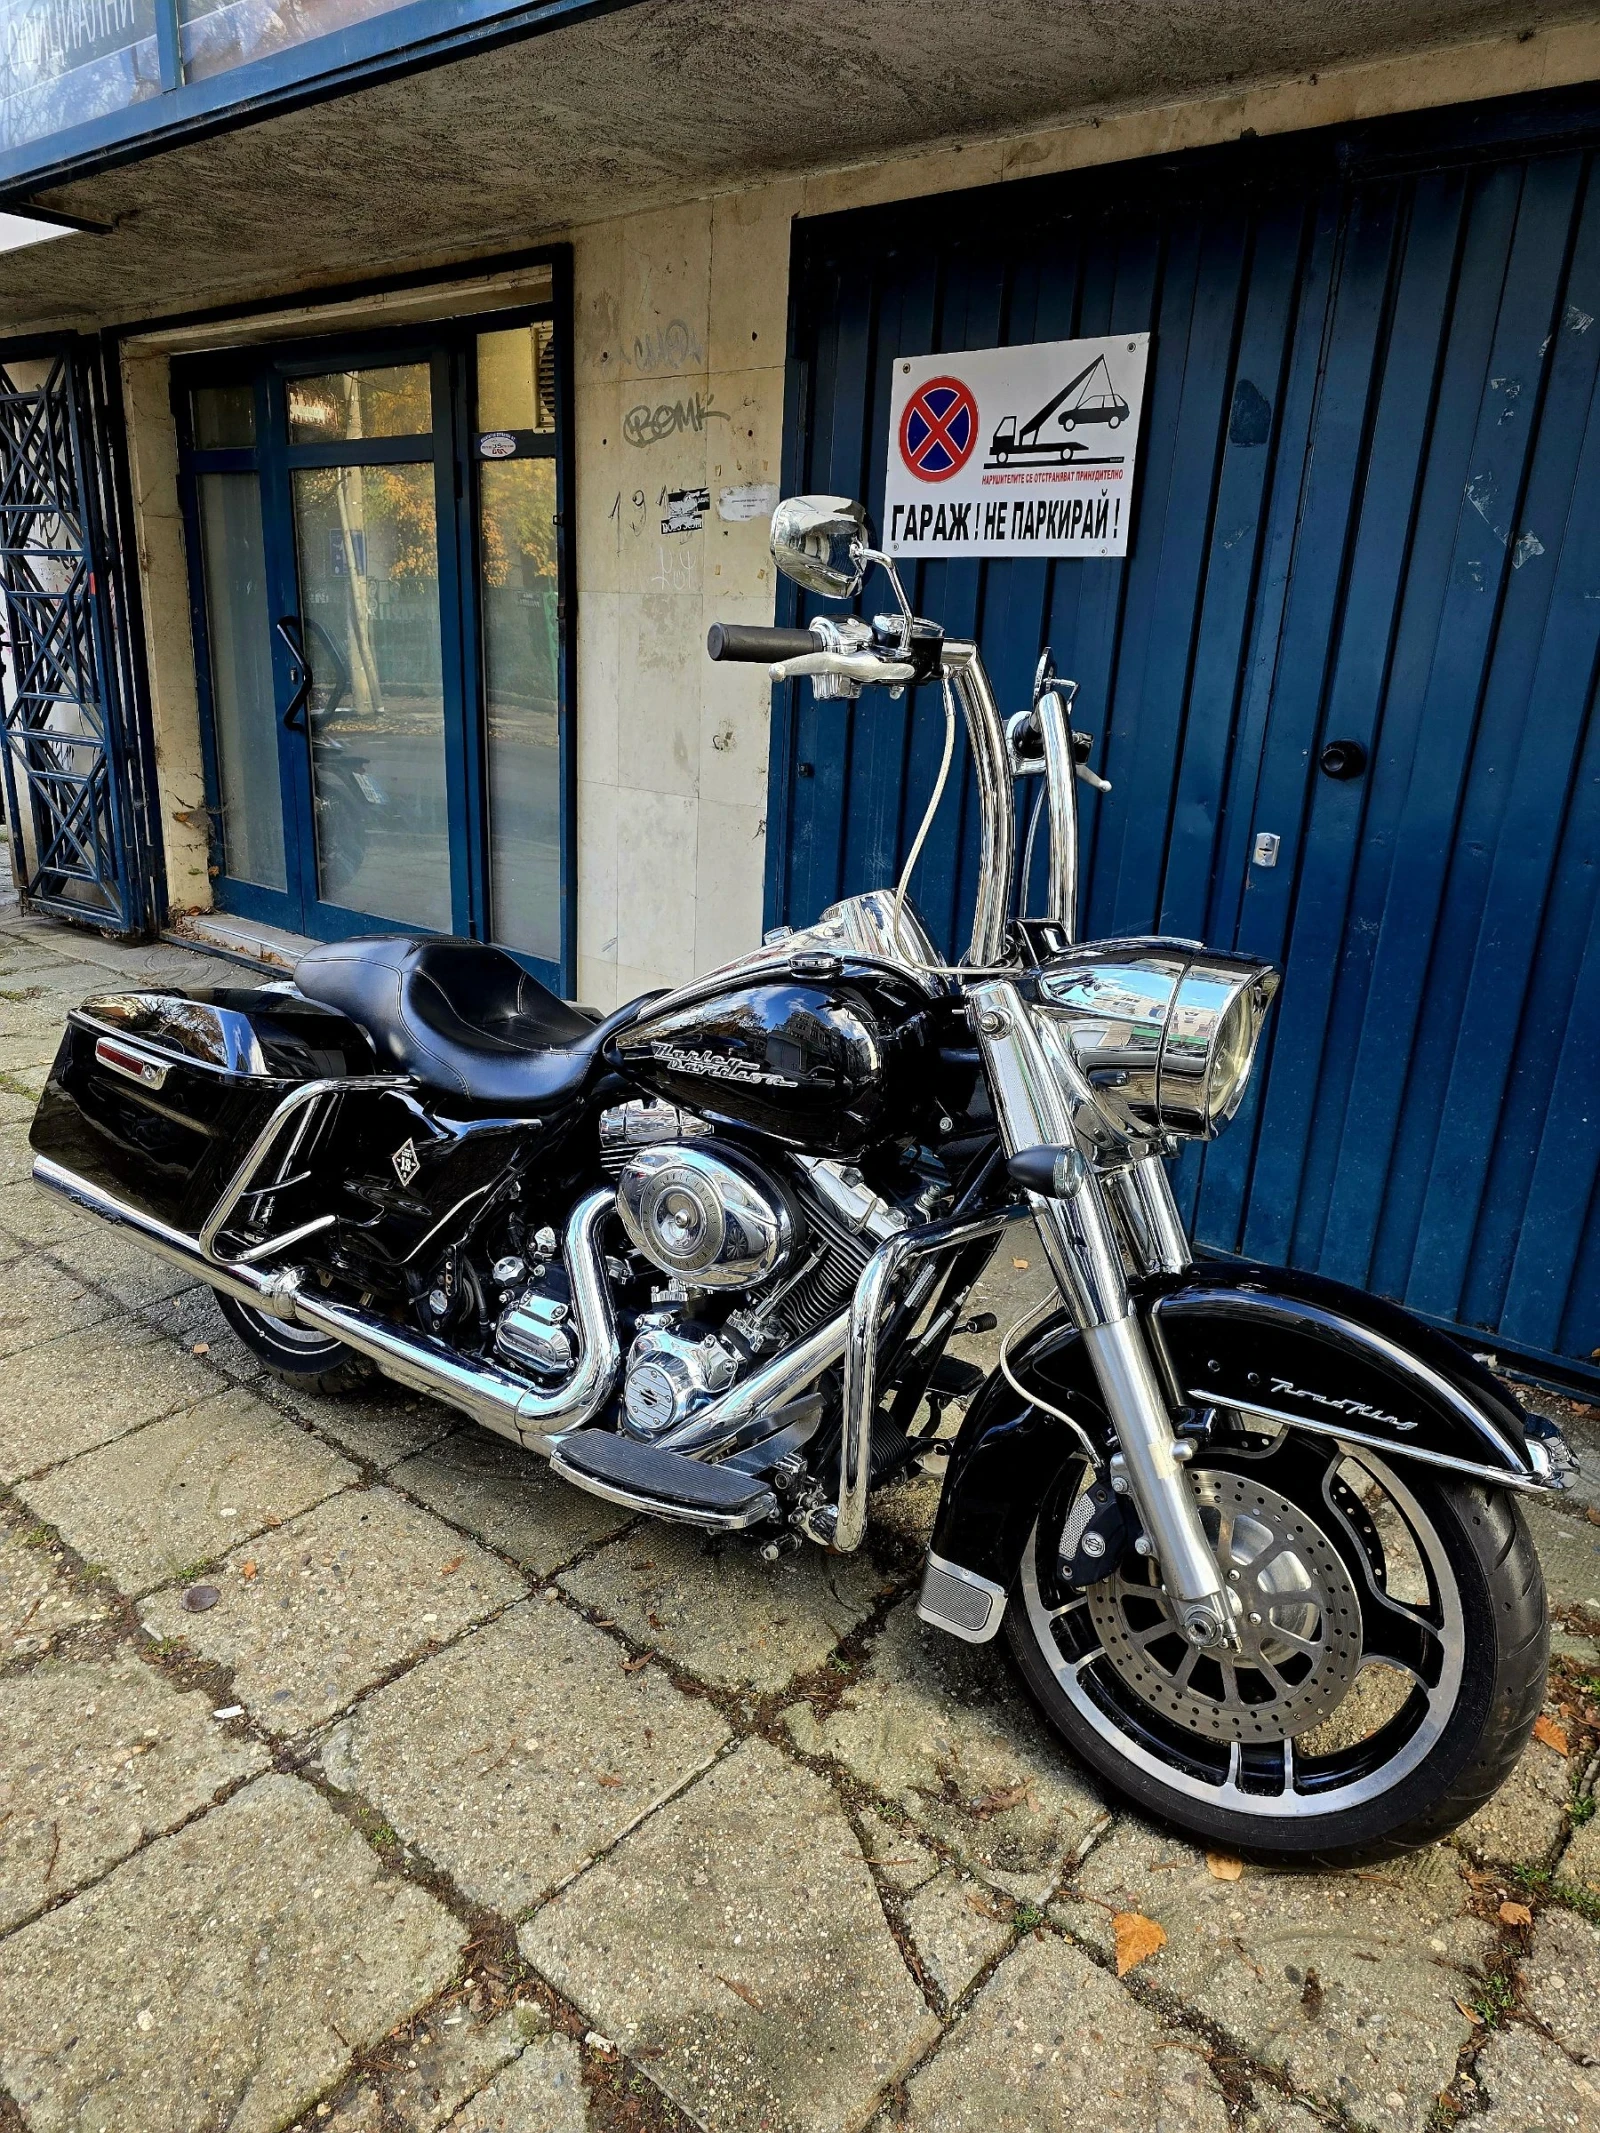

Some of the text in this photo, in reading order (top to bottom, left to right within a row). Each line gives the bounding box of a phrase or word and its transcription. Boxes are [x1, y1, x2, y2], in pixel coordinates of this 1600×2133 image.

[982, 469, 1124, 485] НАРУШИТЕЛИТЕ СЕ ОТСТРАНЯВАТ ПРИНУДИТЕЛНО
[984, 501, 1007, 540] НЕ
